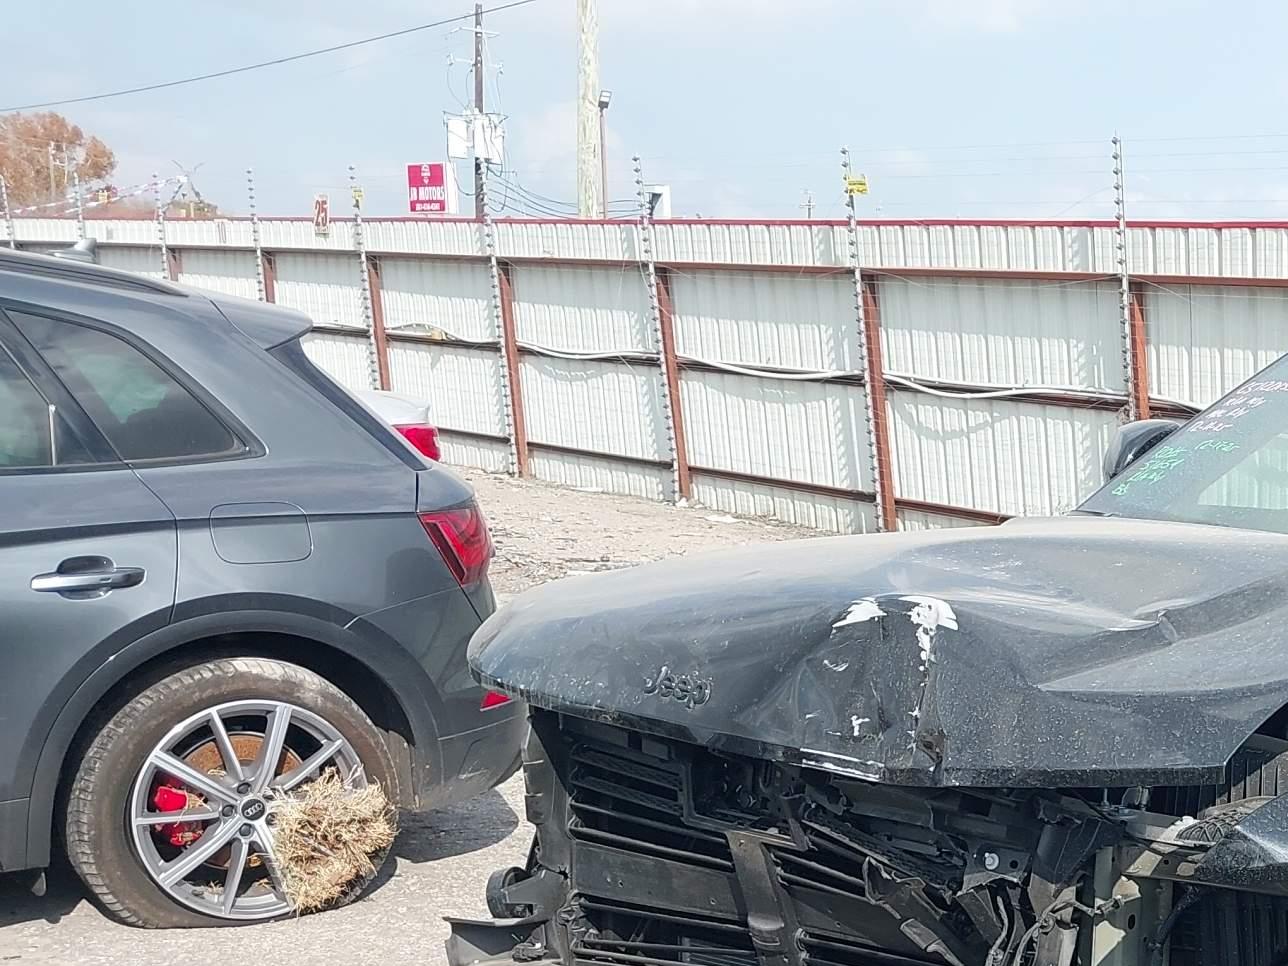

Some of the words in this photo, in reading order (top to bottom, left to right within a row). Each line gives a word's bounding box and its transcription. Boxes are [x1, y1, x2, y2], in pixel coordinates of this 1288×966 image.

[418, 186, 444, 201] MOTORS
[315, 200, 328, 227] 25
[643, 665, 712, 710] Jeep
